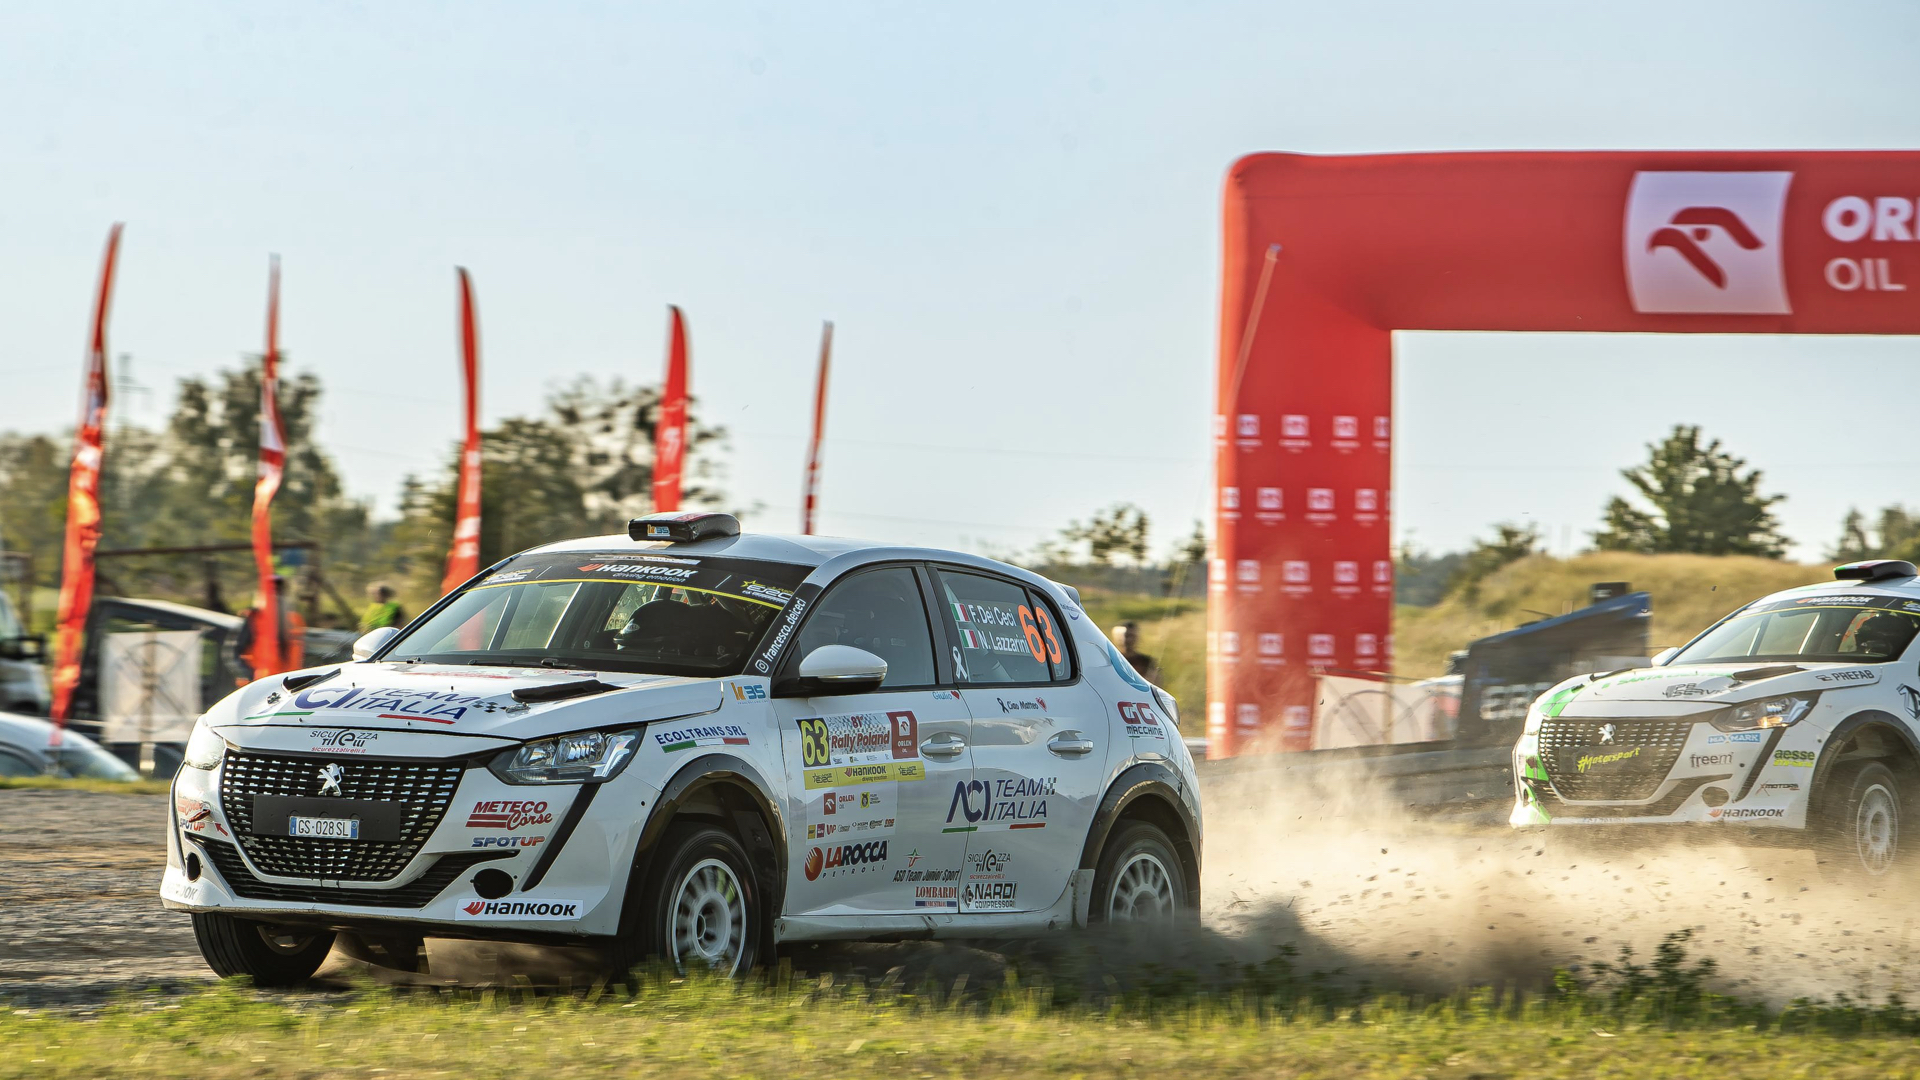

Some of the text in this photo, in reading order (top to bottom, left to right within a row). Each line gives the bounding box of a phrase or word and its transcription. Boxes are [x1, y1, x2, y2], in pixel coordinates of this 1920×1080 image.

[1821, 196, 1920, 242] OR
[1824, 257, 1907, 291] OIL
[646, 574, 686, 583] emotion
[968, 604, 1017, 627] F. Dei Ceci
[762, 597, 807, 662] francesco_deiceci
[1017, 604, 1062, 664] 63
[977, 630, 1031, 654] N. Lazzarini
[1831, 669, 1875, 681] PREFAB
[370, 687, 481, 704] TEAM
[1007, 700, 1039, 710] Ciao Matteo
[349, 698, 471, 720] ITALIA
[1117, 701, 1159, 726] GG
[655, 725, 747, 745] ECOLTRANS SRL
[800, 719, 829, 766] 63
[831, 730, 890, 752] Rally Poland
[1577, 747, 1641, 773] #Motorsport
[1690, 752, 1733, 768] freem
[1774, 749, 1816, 760] aesse
[996, 777, 1044, 798] TEAM
[472, 801, 548, 813] METECO
[839, 794, 855, 803] ORLEN
[990, 800, 1047, 820] ITALIA
[506, 811, 553, 831] Corse
[471, 836, 545, 847] SPOTUP
[893, 867, 960, 883] ASD Team Junior Sport
[915, 886, 957, 898] LOMBARDI
[974, 882, 1017, 900] NARDI
[974, 901, 1017, 909] COMPRESSORI
